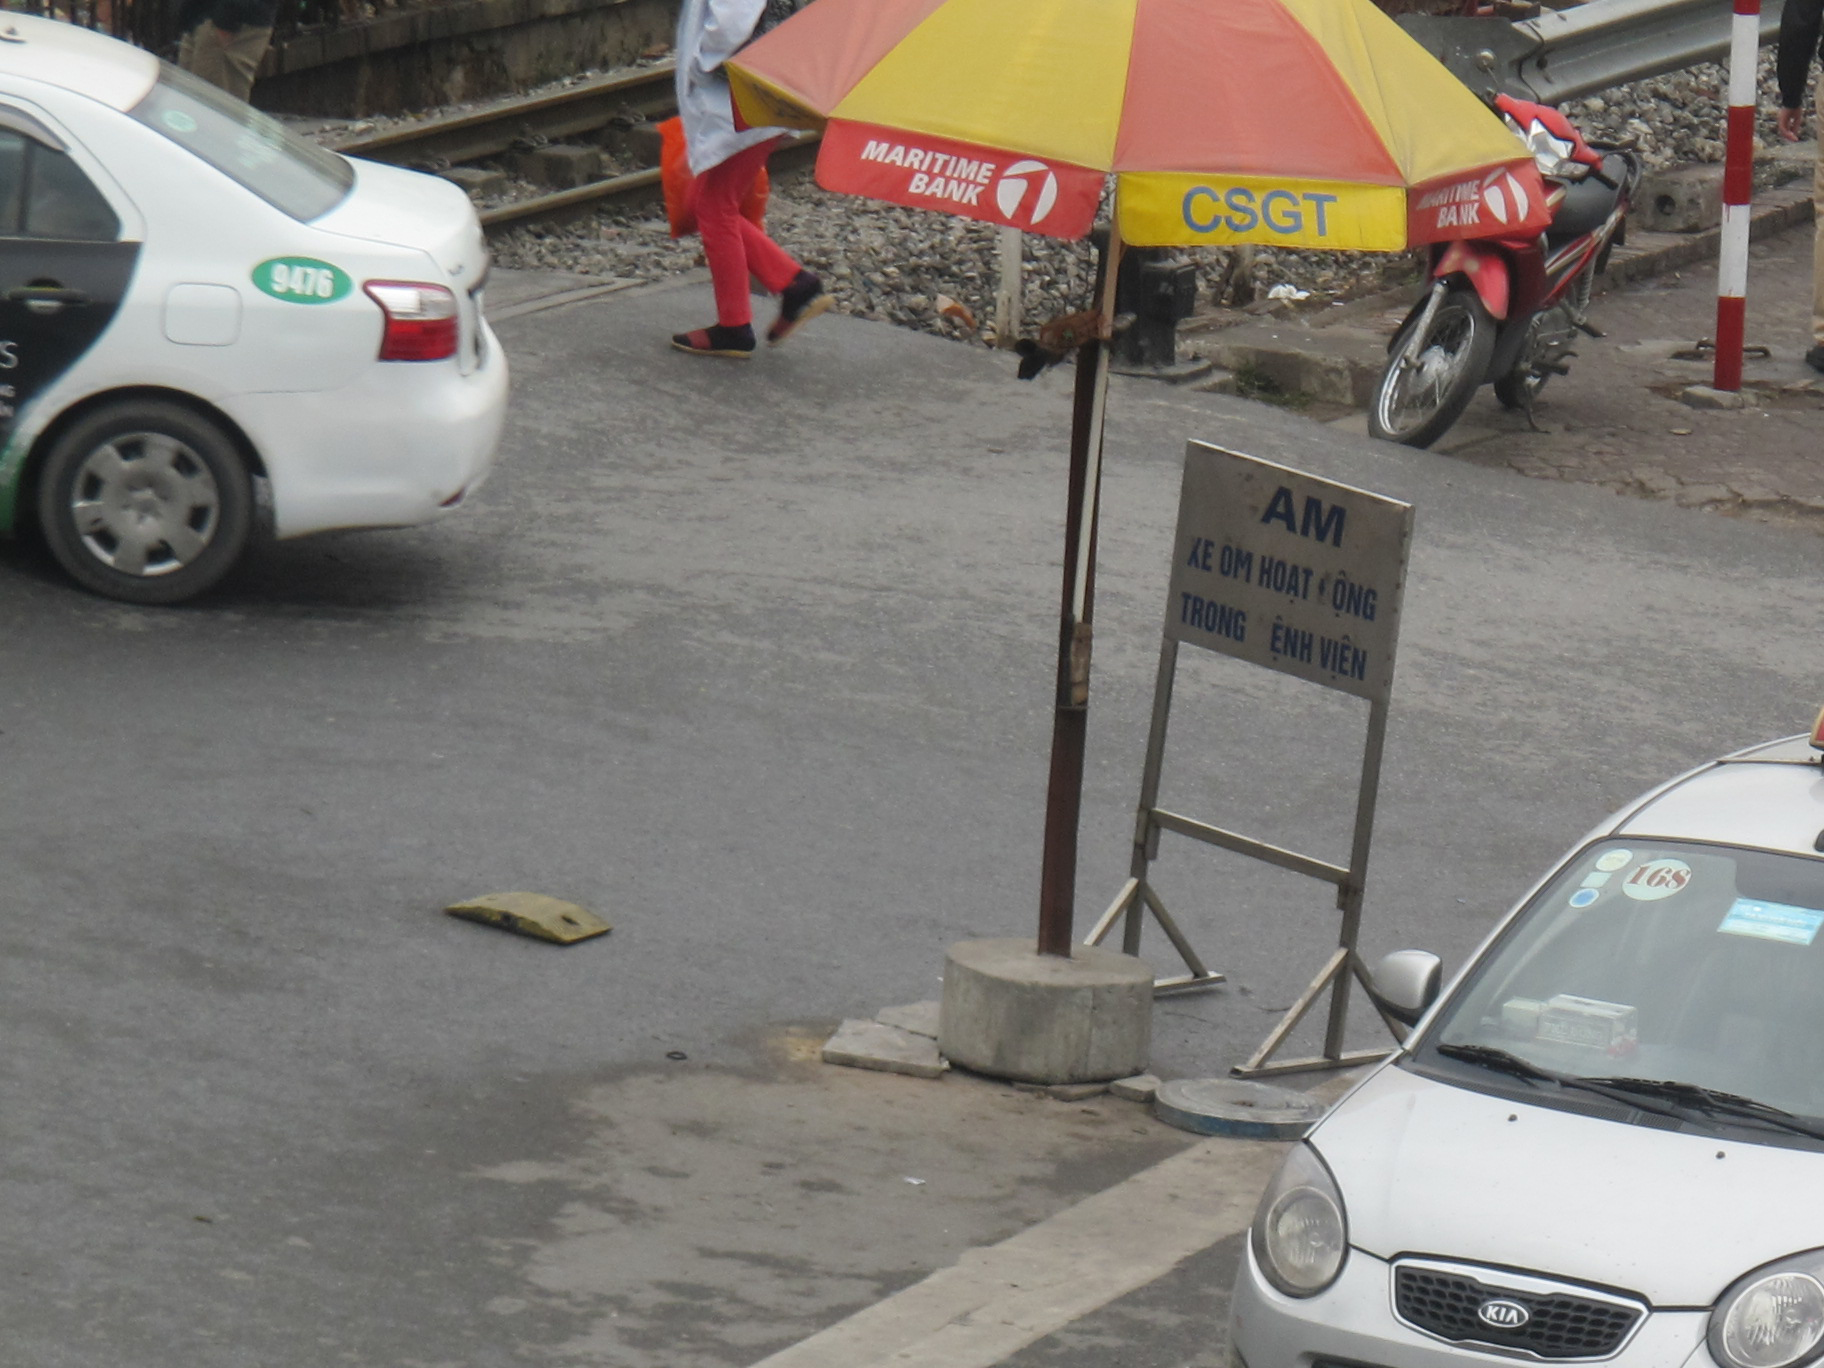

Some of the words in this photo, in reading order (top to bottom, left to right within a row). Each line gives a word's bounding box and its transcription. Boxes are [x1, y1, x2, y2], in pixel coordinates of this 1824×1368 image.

[860, 140, 996, 185] MARITIME
[908, 173, 986, 206] BANK
[1181, 185, 1338, 237] CSGT
[1436, 202, 1481, 228] BANK
[270, 262, 335, 299] 9476
[1186, 537, 1216, 573] XE
[1319, 569, 1378, 621] ỘNG
[1180, 592, 1248, 643] TRONG
[1269, 615, 1314, 663] ỆNH
[1626, 864, 1693, 890] 168
[1485, 1304, 1519, 1324] KIA
